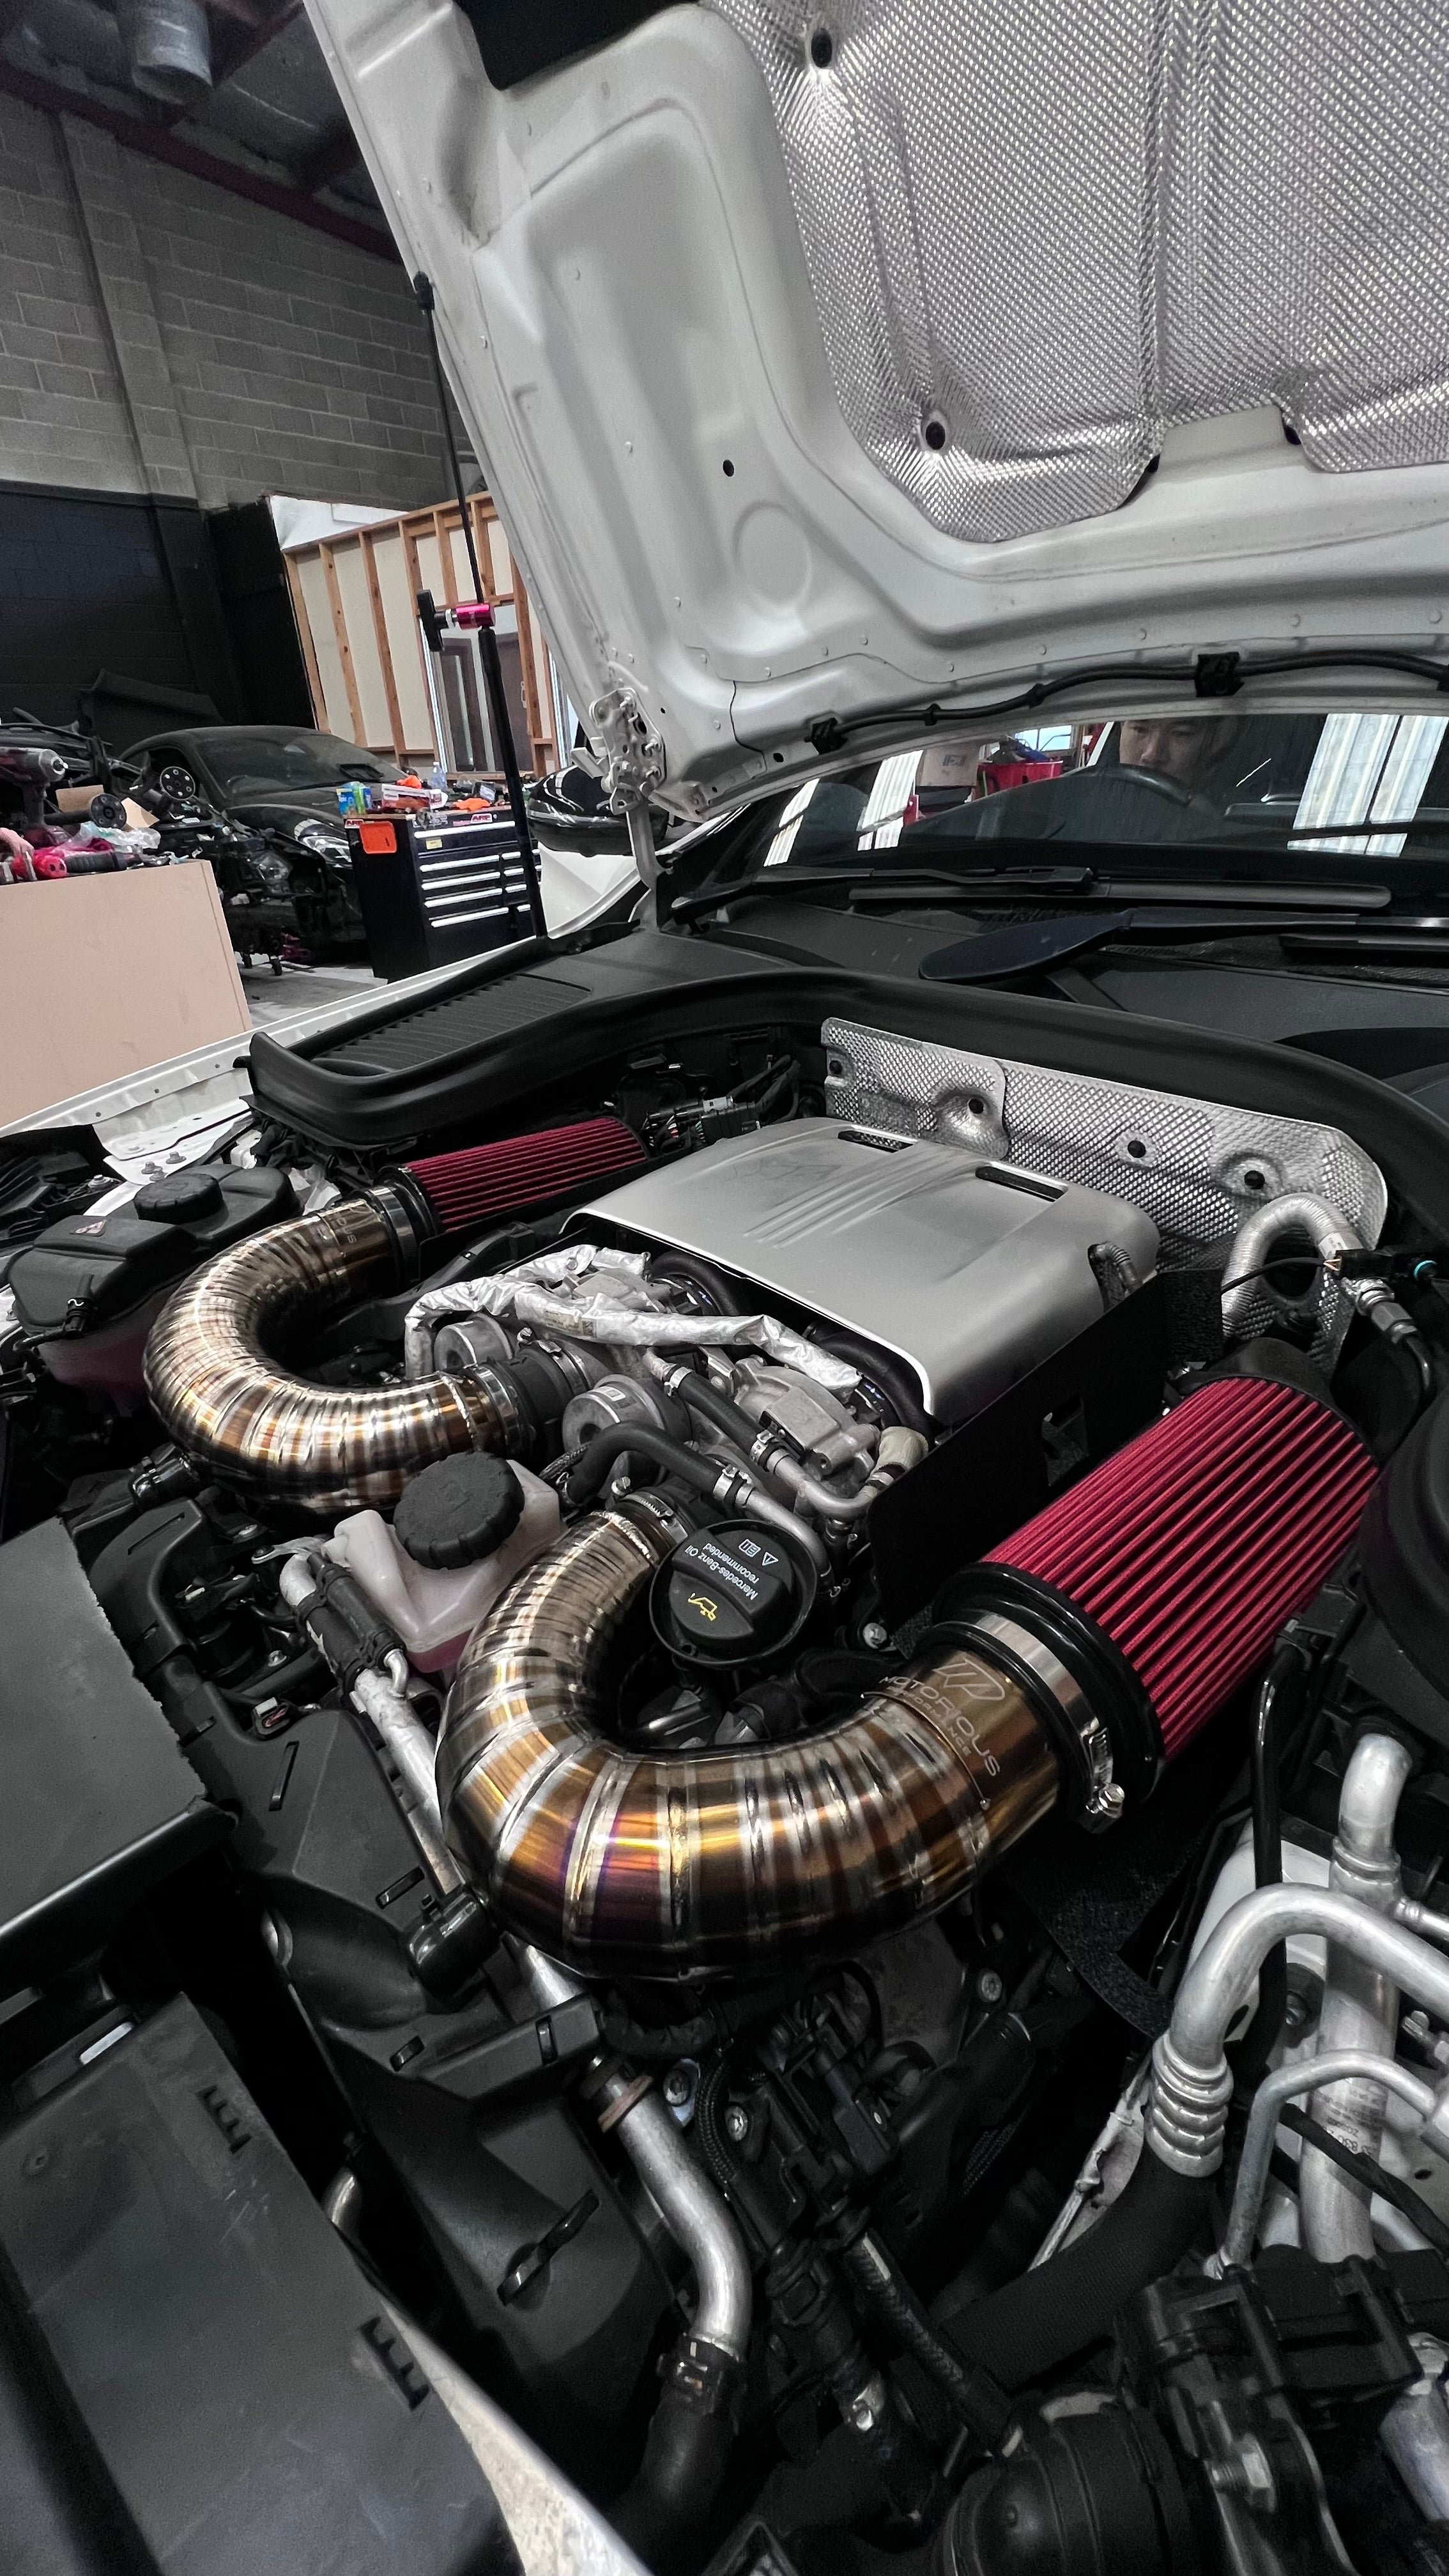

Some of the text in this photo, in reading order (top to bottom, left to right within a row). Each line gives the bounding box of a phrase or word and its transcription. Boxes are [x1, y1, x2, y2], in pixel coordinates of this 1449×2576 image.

[685, 1545, 758, 1600] Mercedes-Benz Oil
[703, 1543, 760, 1584] recommended
[878, 1676, 1000, 1776] MOTORIOUS
